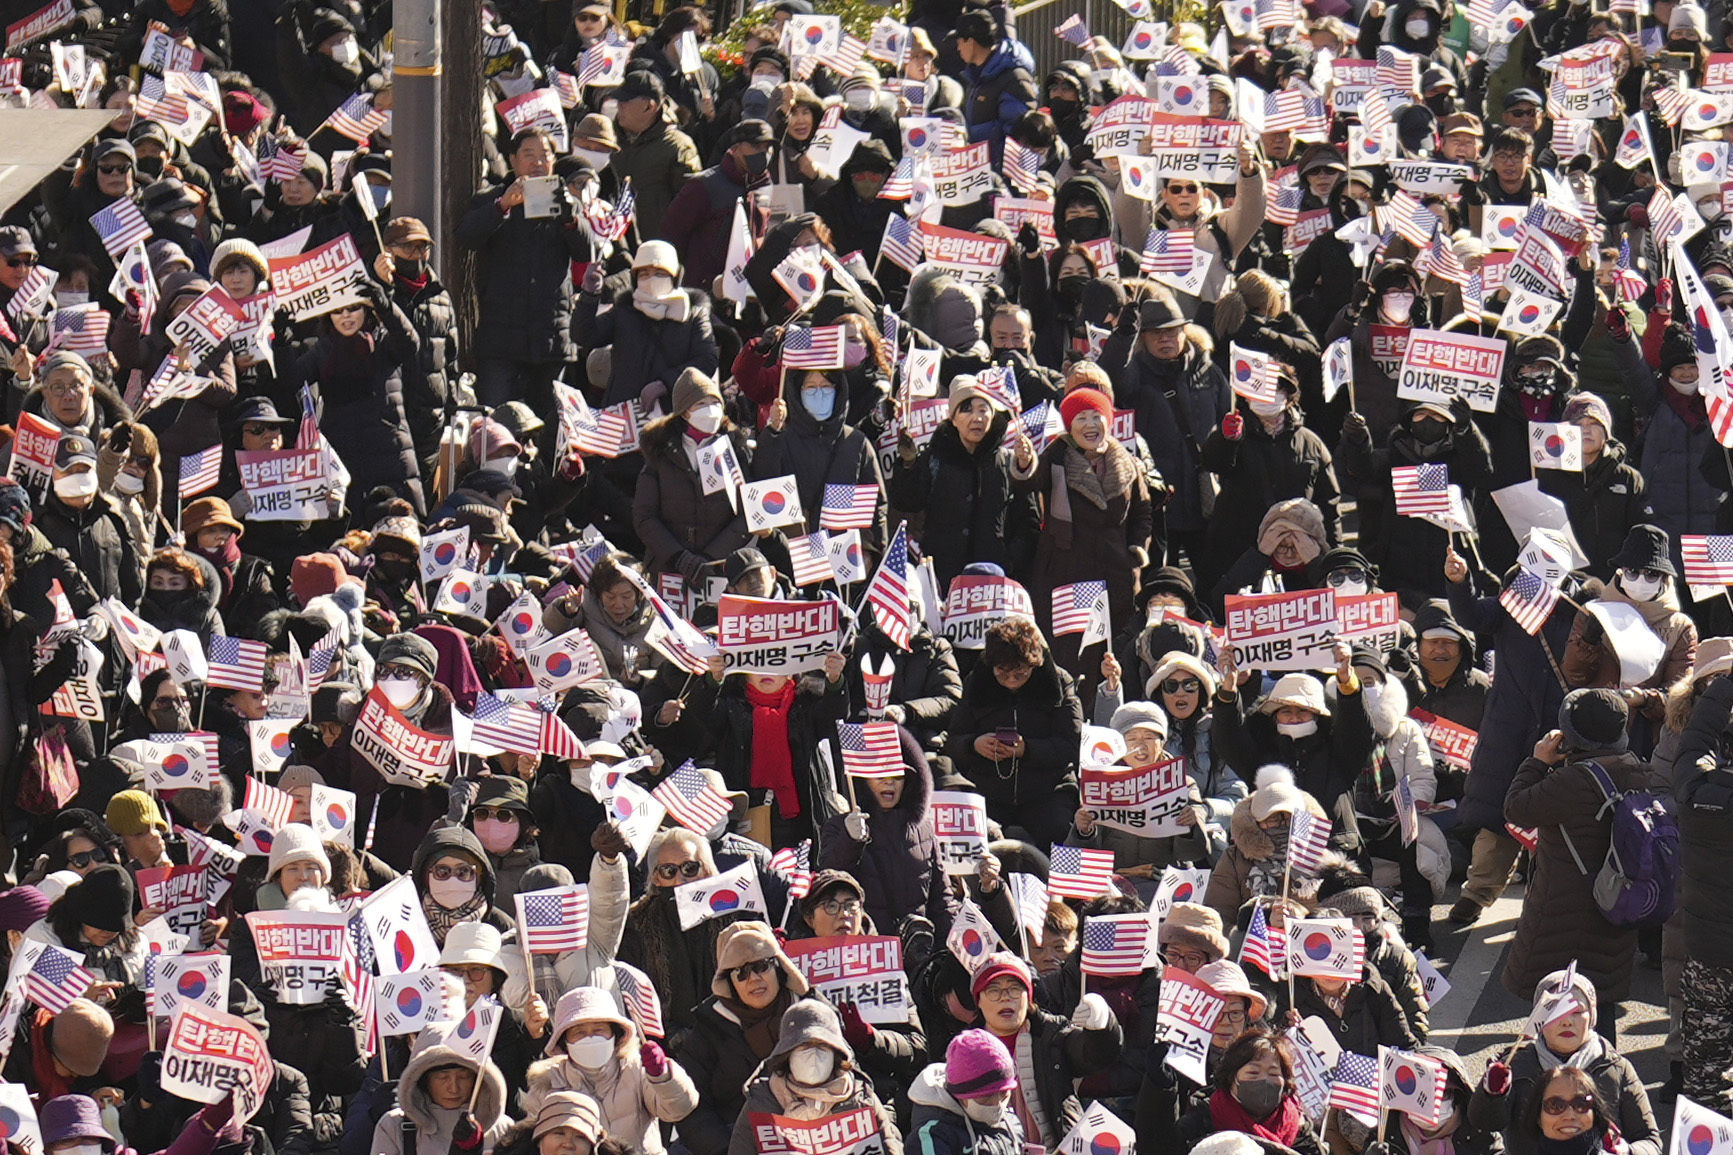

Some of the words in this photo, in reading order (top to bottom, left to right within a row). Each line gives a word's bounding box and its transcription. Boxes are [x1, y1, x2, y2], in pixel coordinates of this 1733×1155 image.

[1151, 123, 1242, 148] 탄핵반대
[931, 143, 988, 178] 핵반대
[1151, 154, 1199, 173] 이재명
[1202, 153, 1236, 170] 구속
[1393, 163, 1431, 180] 재명
[272, 236, 357, 290] 탄핵반대
[922, 232, 1008, 266] 탄핵반대
[280, 282, 332, 315] 이재명
[1411, 343, 1500, 374] 탄핵반대
[1403, 369, 1457, 393] 이재명
[1459, 374, 1497, 402] 구속
[240, 458, 328, 488] 탄핵반대
[721, 604, 835, 643] 탄핵반대
[1229, 595, 1334, 640] 탄핵반대
[1338, 596, 1395, 630] 반대
[946, 620, 1004, 642] 이재
[1233, 637, 1293, 665] 이재명
[1295, 630, 1338, 654] 구속
[724, 646, 789, 669] 이재명
[365, 703, 452, 765] 탄핵반대
[356, 731, 399, 777] 이재명
[1084, 764, 1184, 805] 탄핵반대
[931, 807, 985, 835] 반대
[1090, 805, 1147, 828] 이재명
[1150, 797, 1187, 826] 구속
[256, 926, 341, 959] 탄핵반대
[858, 979, 902, 1003] 척결
[180, 1022, 261, 1070] 탄핵반
[166, 1058, 239, 1091] 이재명
[760, 1110, 878, 1155] 탄핵반대
